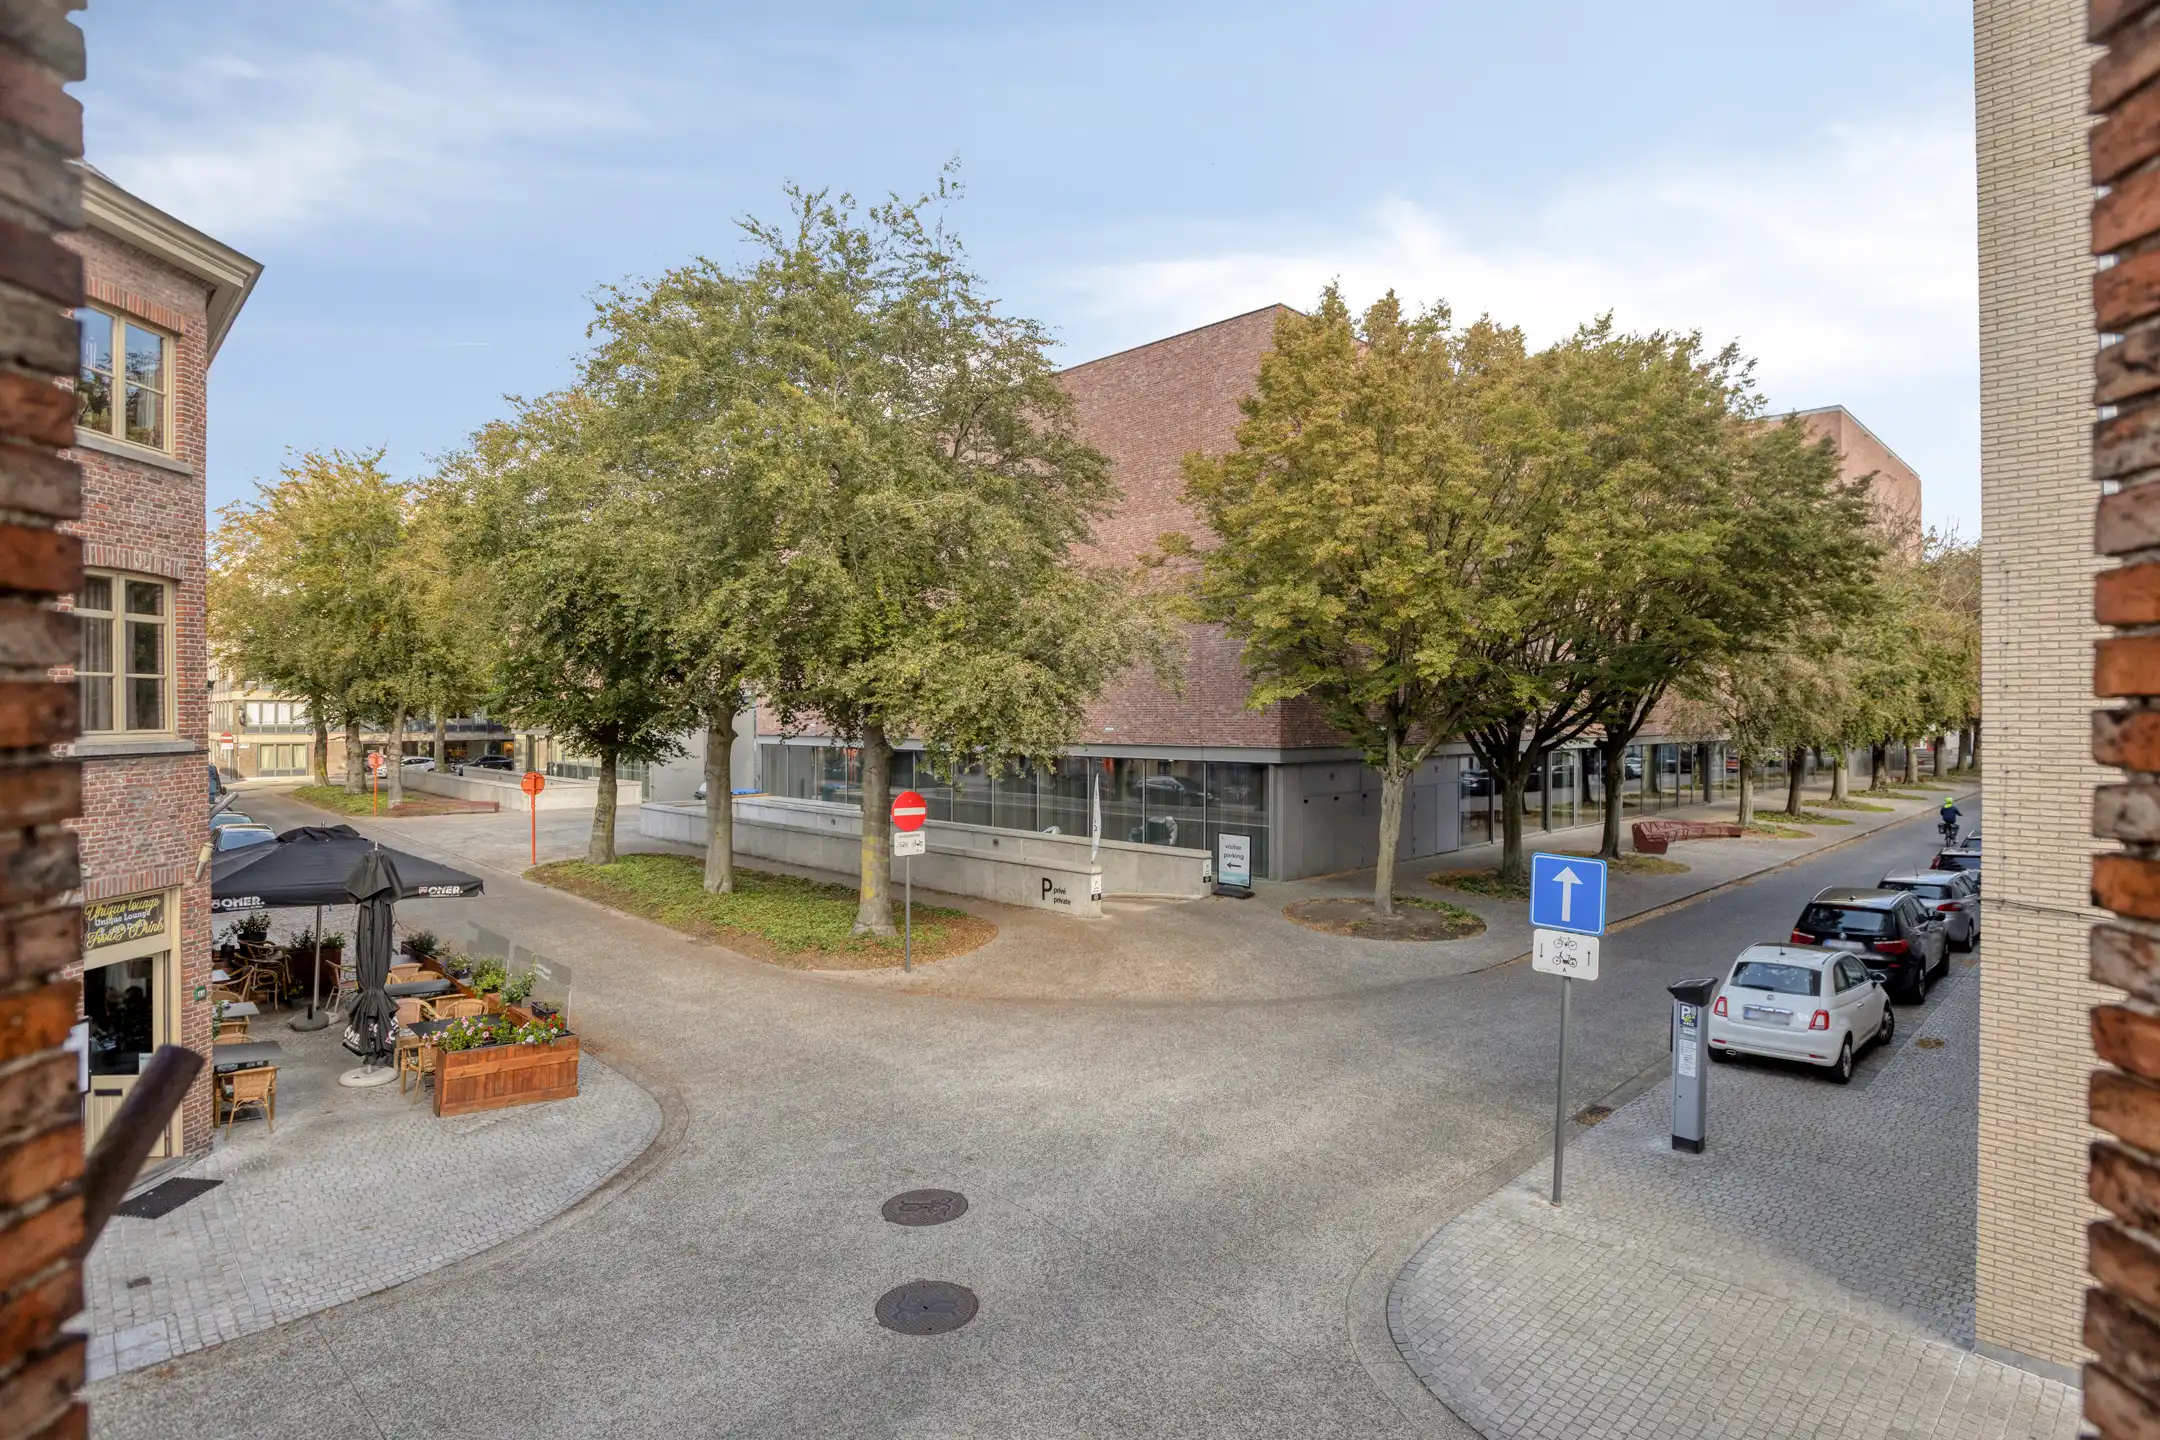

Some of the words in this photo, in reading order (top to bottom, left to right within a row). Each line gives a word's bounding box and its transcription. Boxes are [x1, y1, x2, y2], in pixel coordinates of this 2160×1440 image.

[1223, 852, 1245, 861] parking
[1041, 877, 1053, 901] P
[1053, 886, 1067, 895] privé
[1053, 897, 1072, 906] private
[84, 902, 126, 922] Unique
[1681, 1005, 1692, 1020] P
